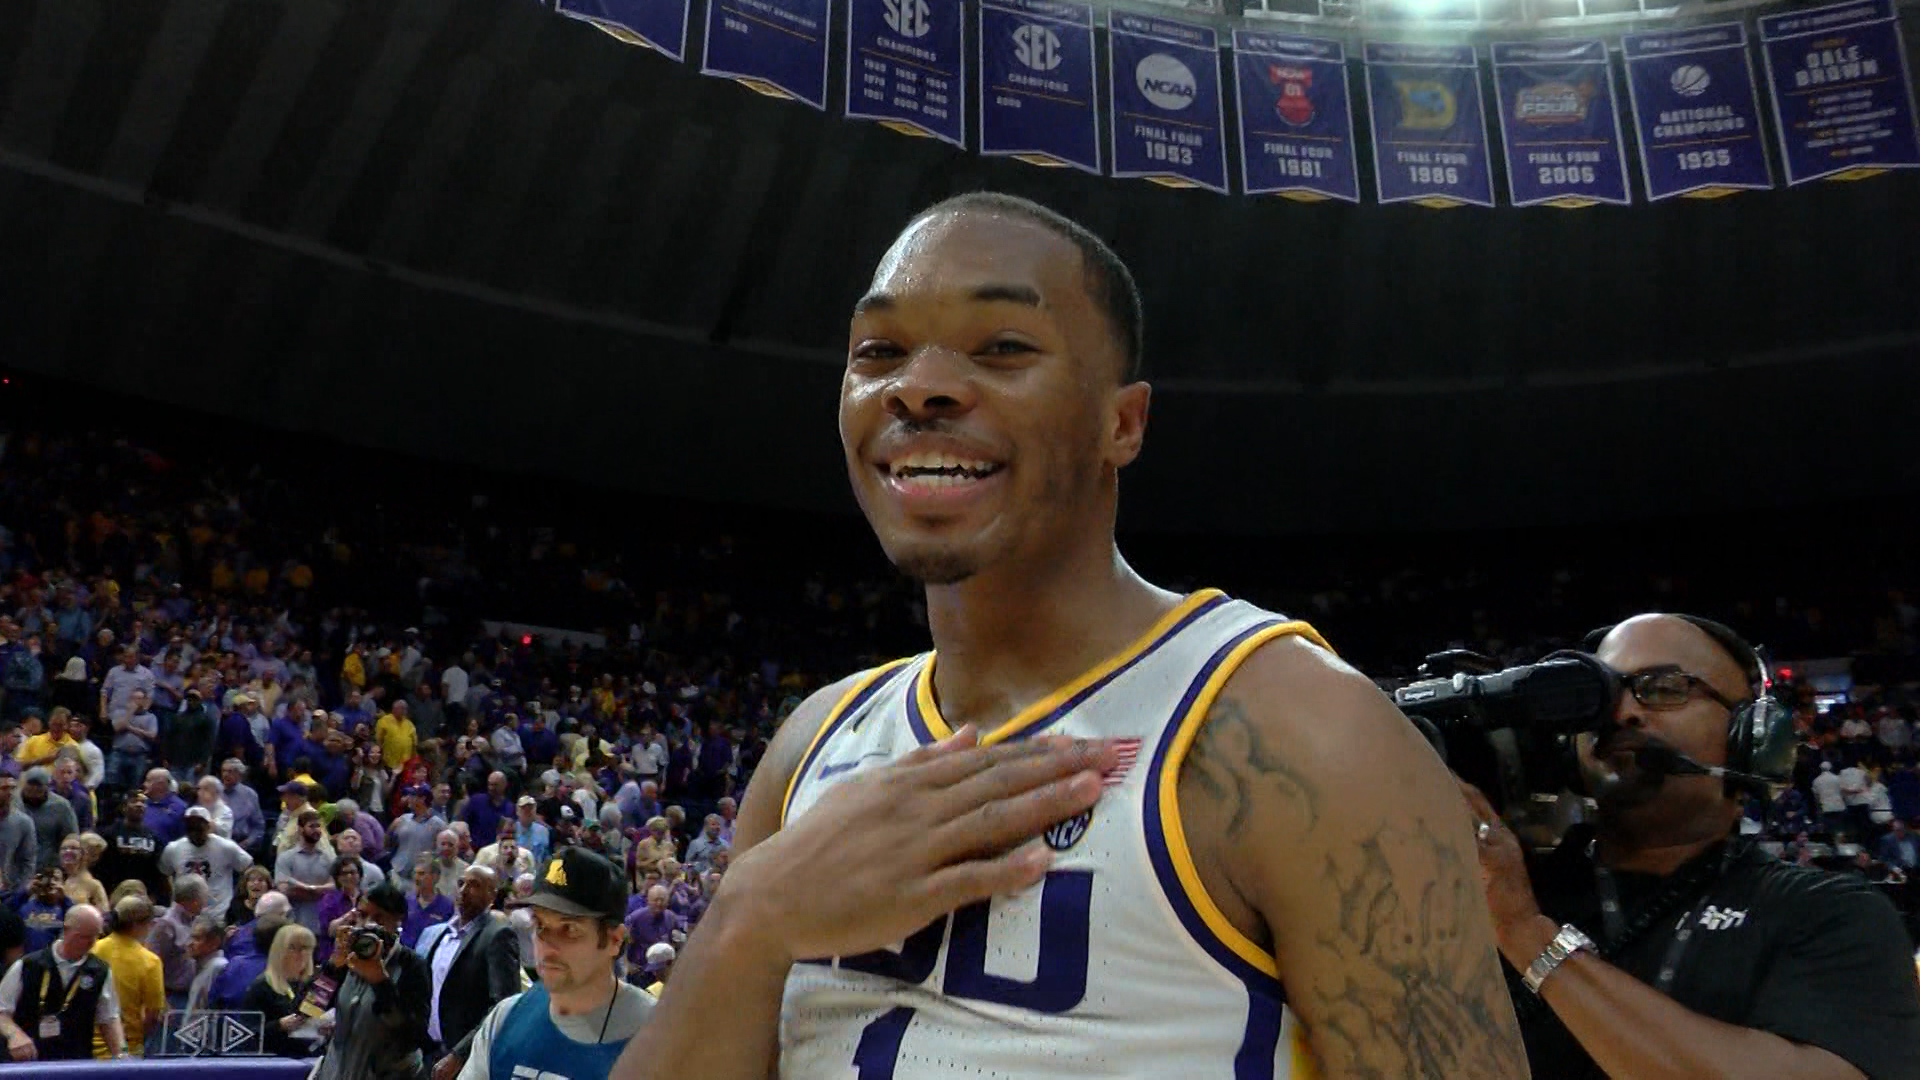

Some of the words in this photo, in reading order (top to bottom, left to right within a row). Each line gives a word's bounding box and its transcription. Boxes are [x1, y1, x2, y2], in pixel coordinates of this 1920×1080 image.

[882, 0, 931, 38] SEC
[1012, 24, 1062, 71] SEC
[1143, 79, 1195, 99] NCAA
[1134, 125, 1168, 142] FINAL
[1171, 131, 1203, 147] FOUR
[1264, 142, 1298, 156] FINAL
[1302, 147, 1333, 159] FOUR
[1397, 151, 1432, 164] FINAL
[1435, 153, 1468, 166] FOUR
[1528, 152, 1564, 165] FINAL
[1567, 151, 1600, 163] FOUR
[1677, 149, 1732, 170] 1935
[1409, 166, 1458, 185] 1986
[1538, 166, 1595, 185] 2006
